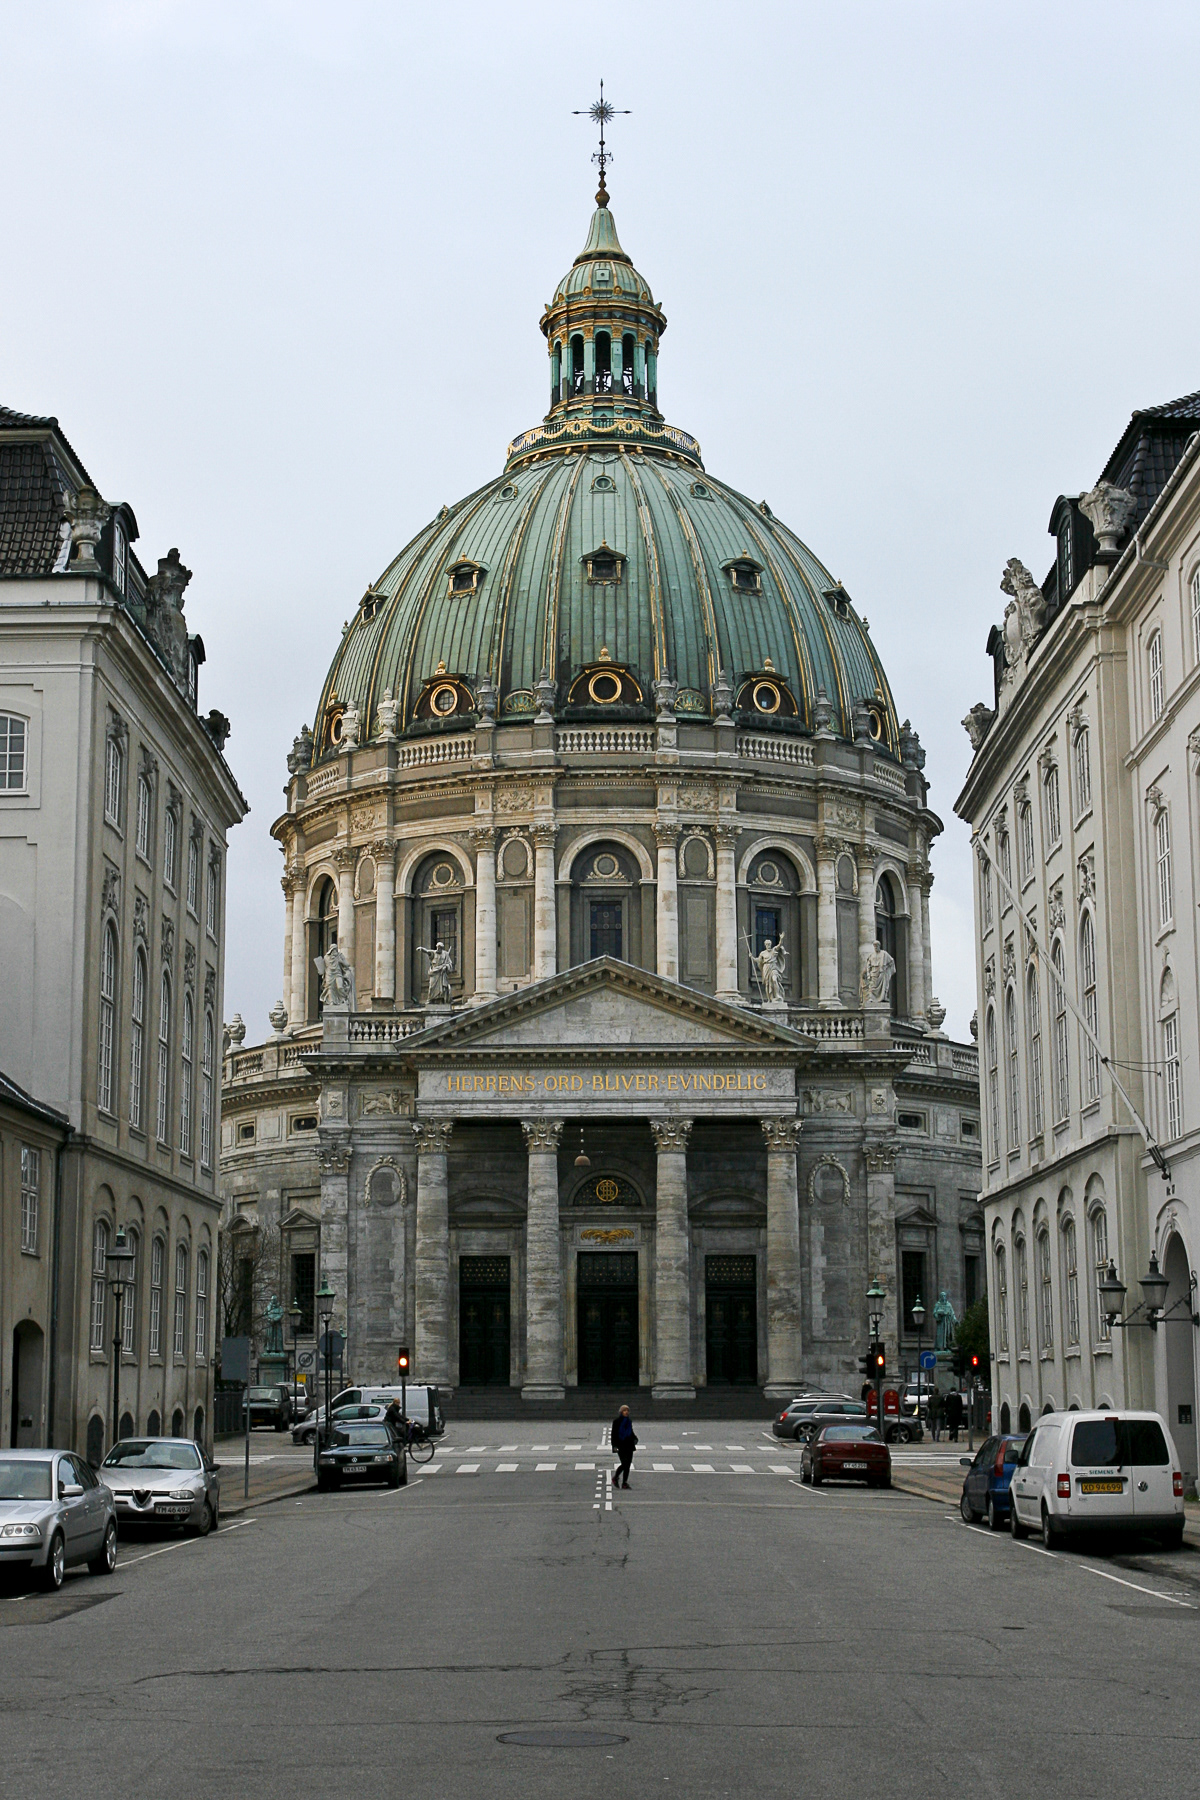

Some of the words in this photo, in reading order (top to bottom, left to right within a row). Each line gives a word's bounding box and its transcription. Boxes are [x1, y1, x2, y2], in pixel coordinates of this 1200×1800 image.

[447, 1075, 536, 1092] HERRENS
[544, 1075, 583, 1091] ORD
[592, 1075, 659, 1091] BLIVER
[667, 1074, 767, 1090] EVINDELIG
[1084, 1483, 1094, 1491] XD
